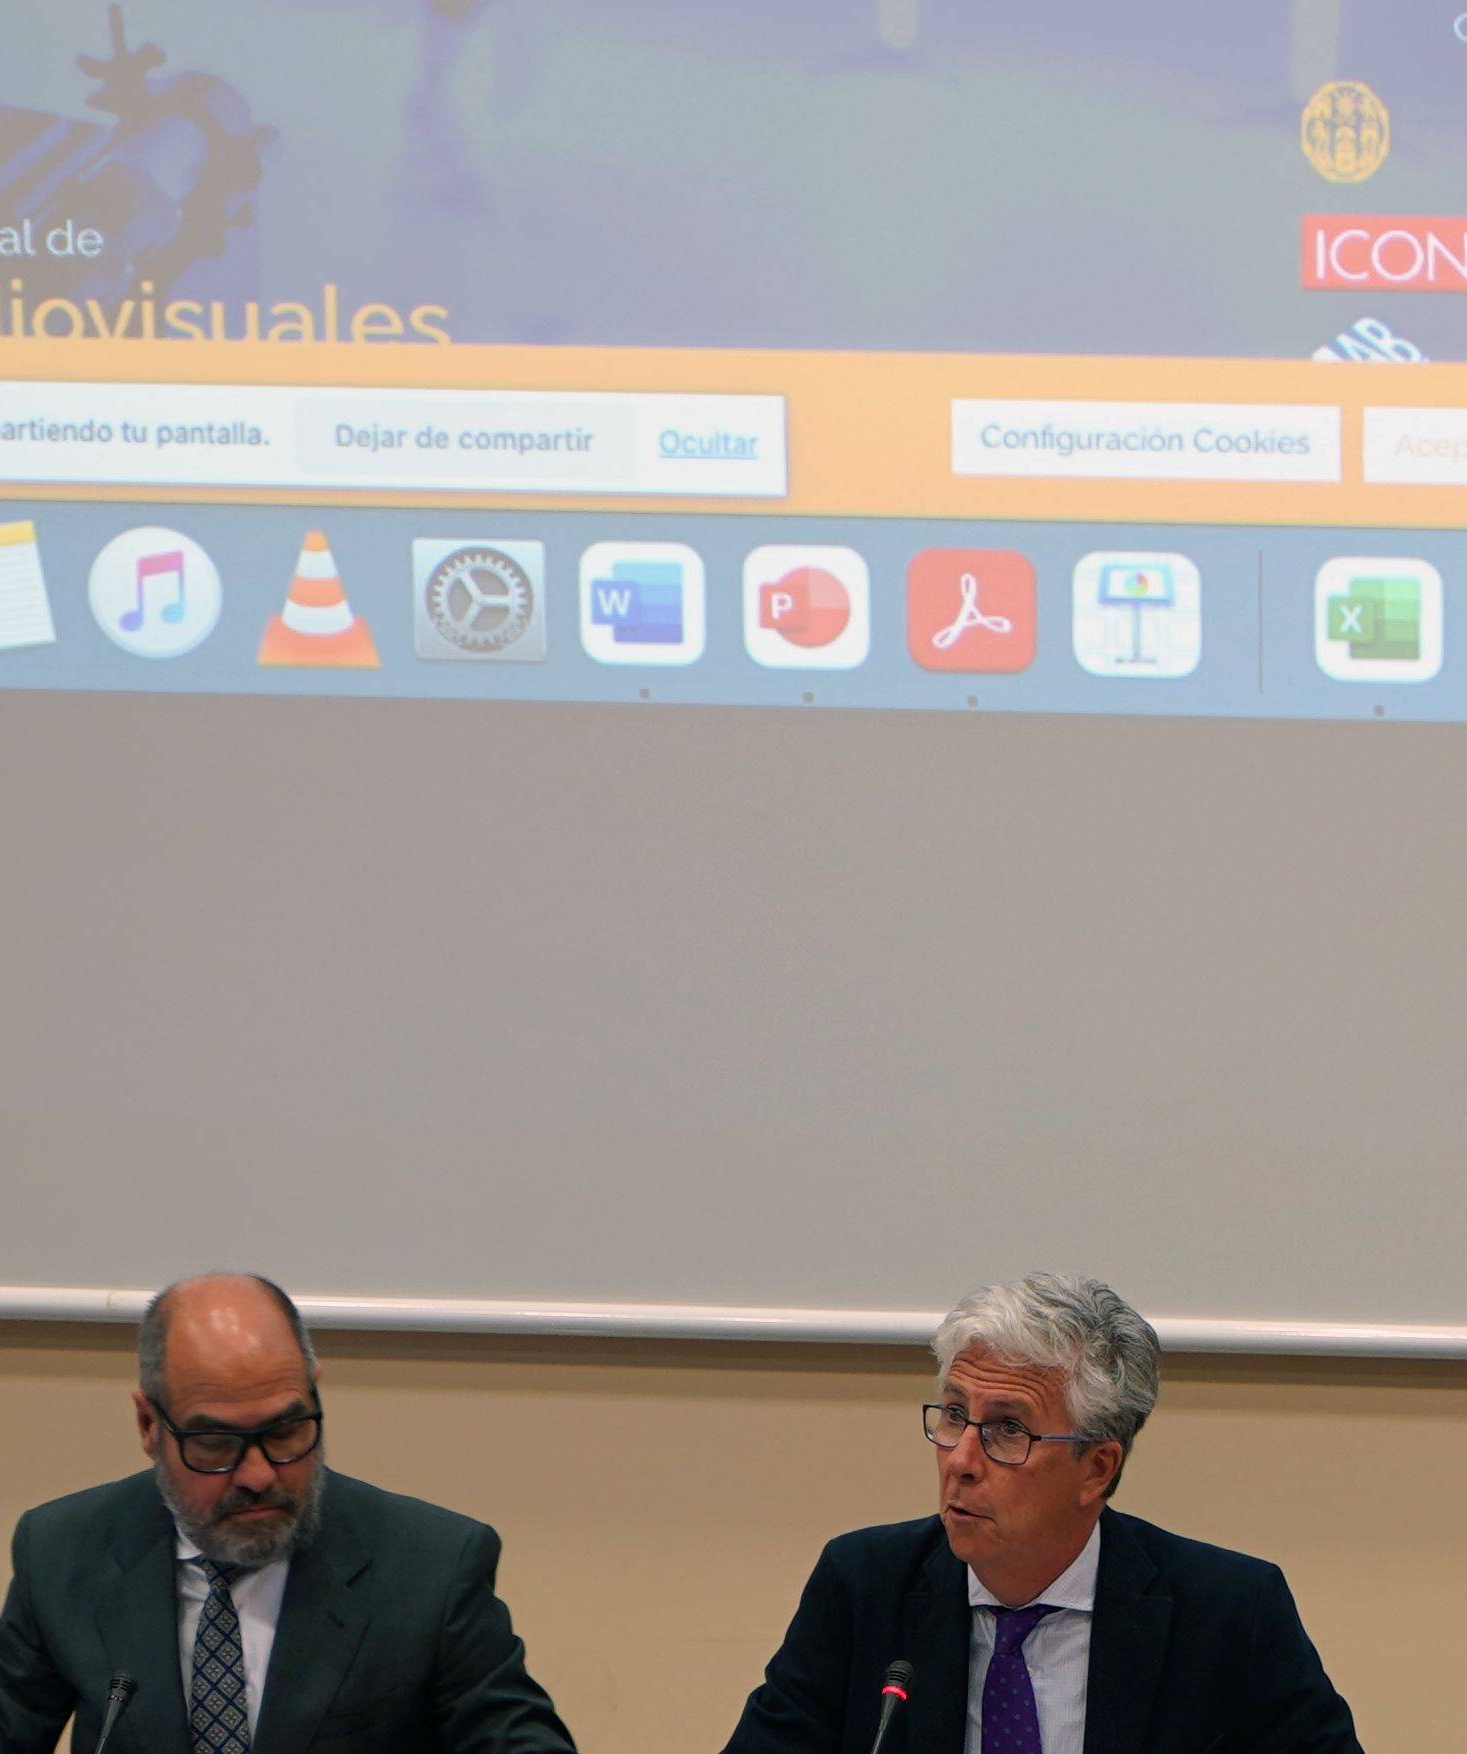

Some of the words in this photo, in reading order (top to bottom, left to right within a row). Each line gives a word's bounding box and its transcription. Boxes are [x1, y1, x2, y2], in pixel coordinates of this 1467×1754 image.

[46, 219, 104, 258] de
[121, 420, 149, 446] tu
[155, 419, 271, 449] pantalla.
[334, 422, 408, 456] Dejar
[415, 424, 450, 451] de
[457, 426, 594, 456] compartir
[658, 427, 760, 456] Ocultar
[980, 423, 1185, 457] Configuración
[1192, 427, 1312, 457] Cookies
